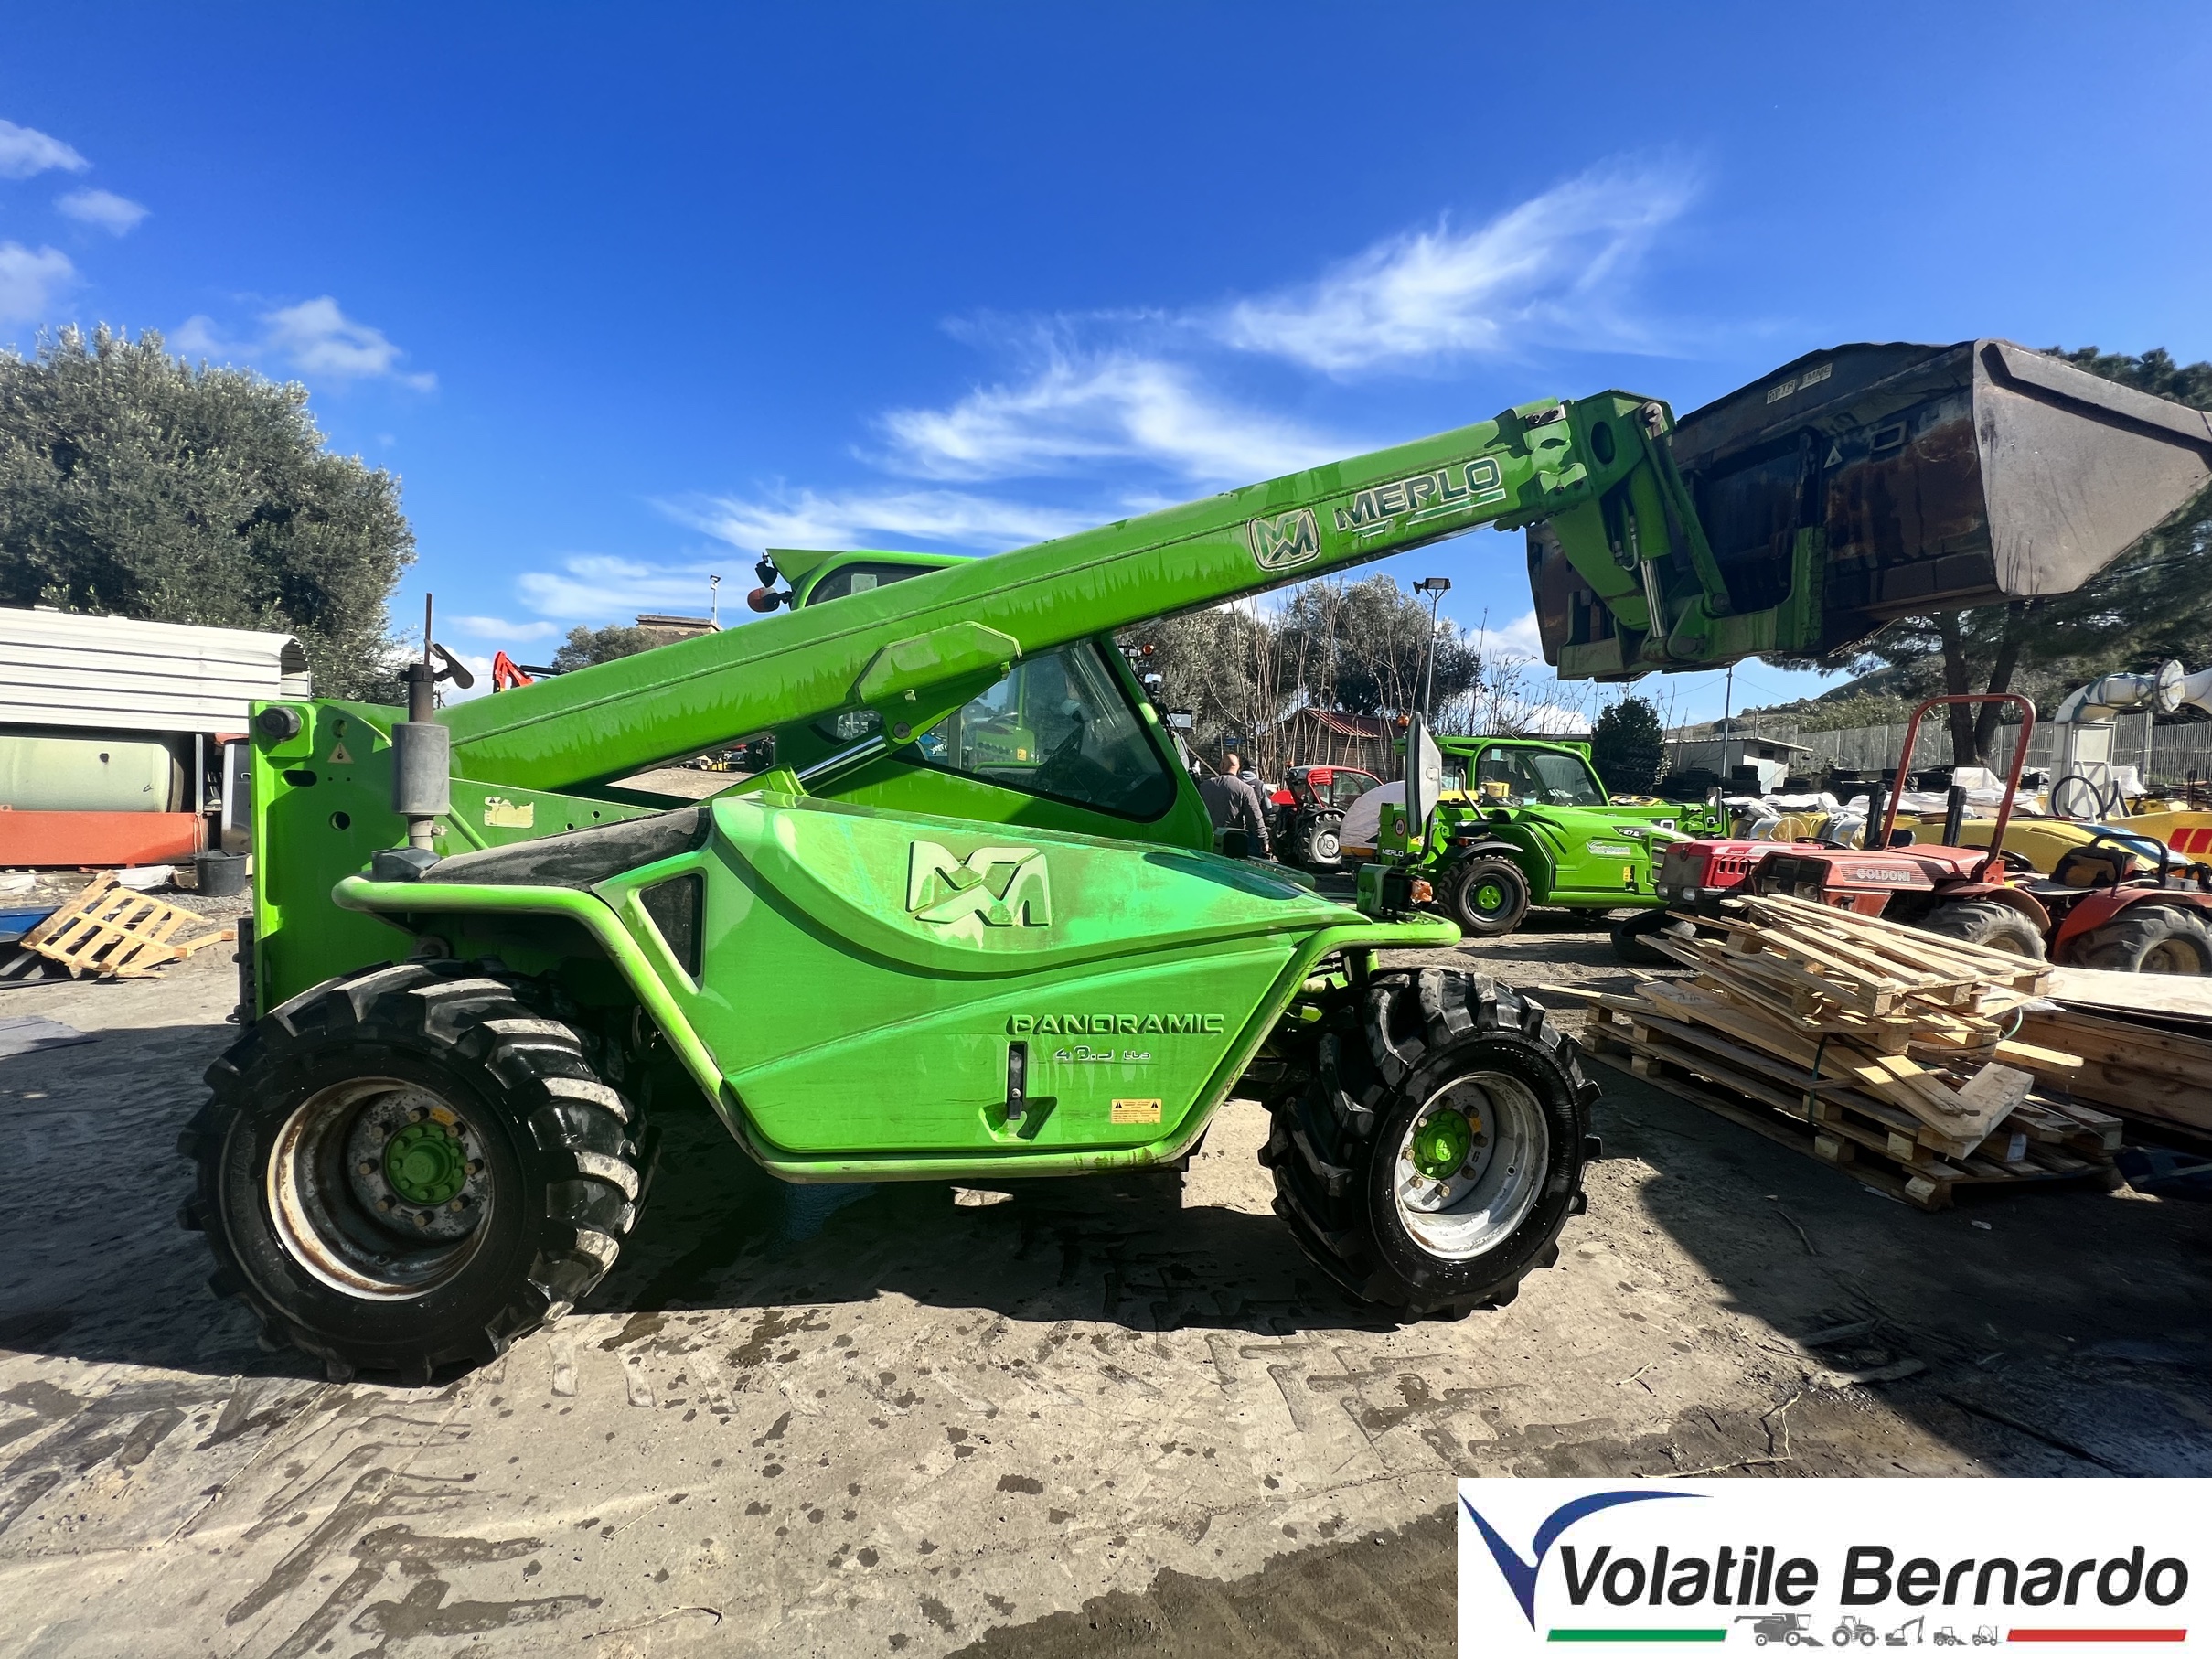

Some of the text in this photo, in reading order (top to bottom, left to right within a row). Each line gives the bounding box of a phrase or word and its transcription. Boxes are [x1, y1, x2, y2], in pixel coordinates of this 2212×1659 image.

[1332, 457, 1502, 532] MERLO
[1382, 848, 1405, 857] MERLO
[1856, 868, 1911, 882] GOLDONI
[1006, 1013, 1224, 1035] PANORAMIC
